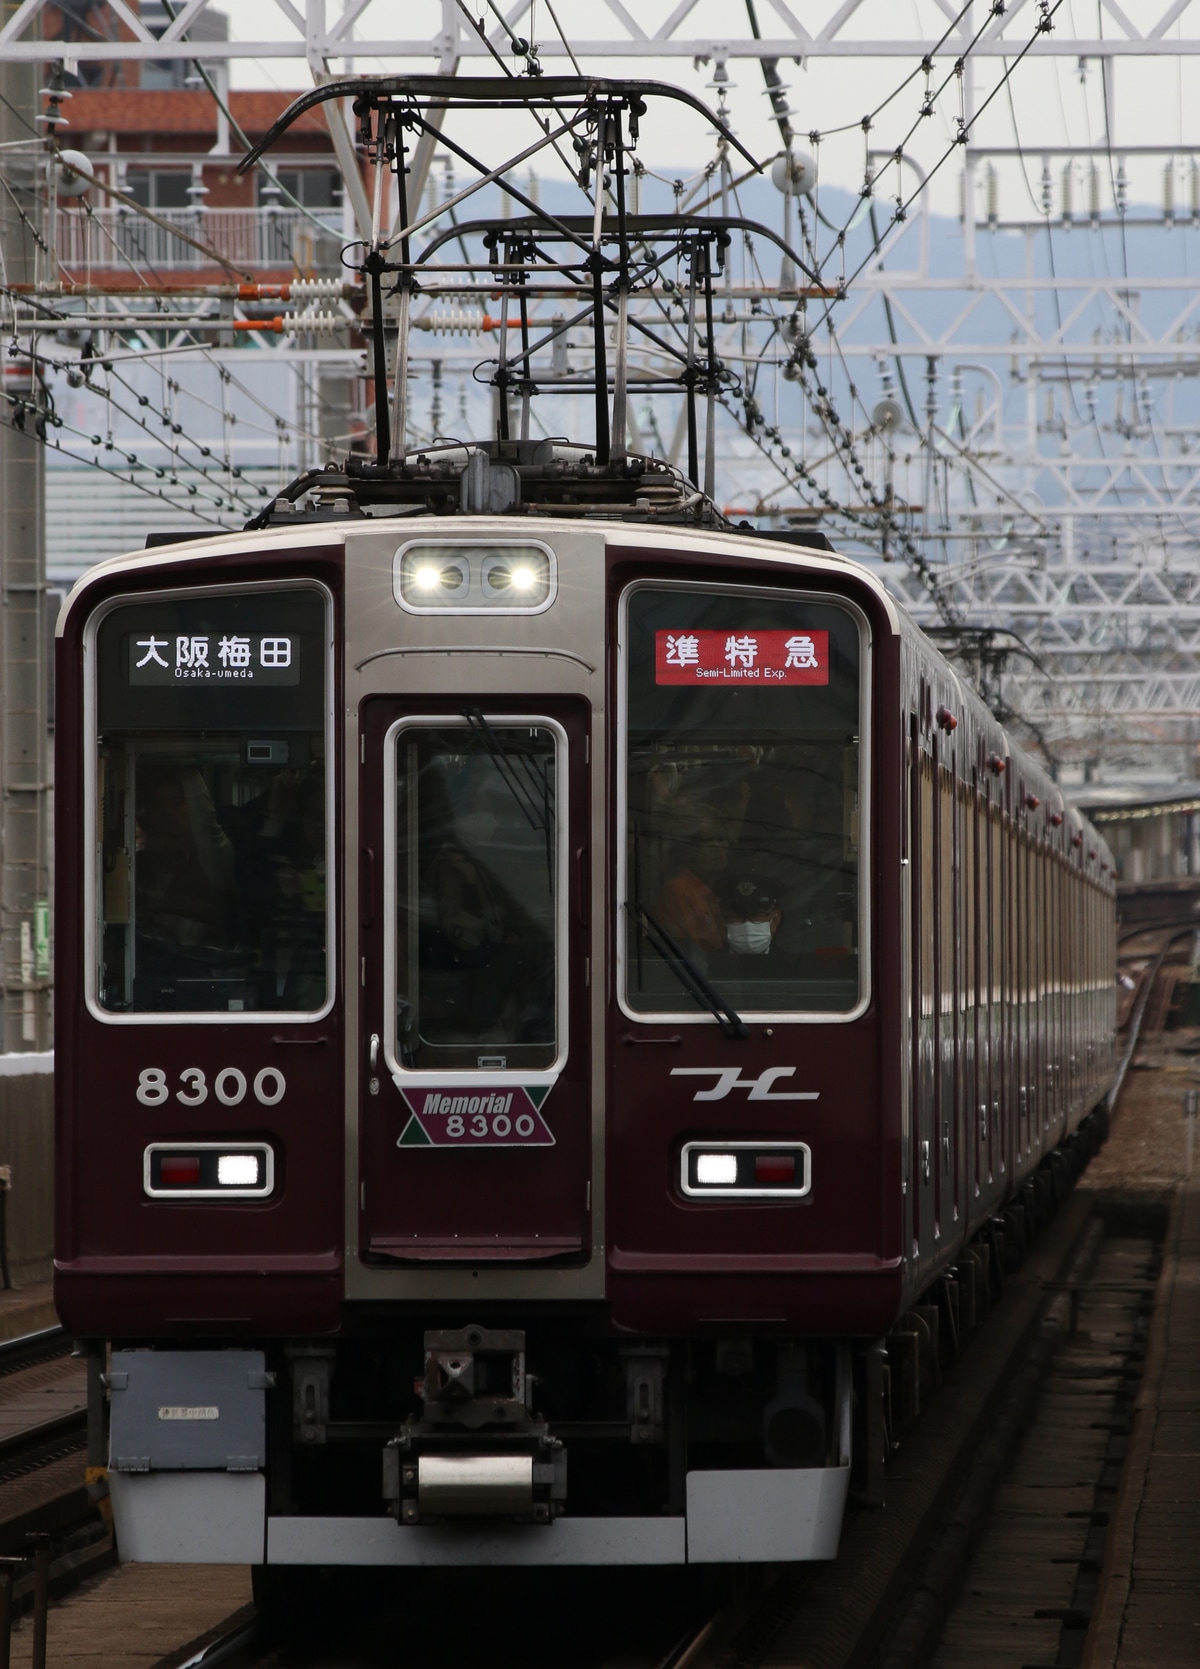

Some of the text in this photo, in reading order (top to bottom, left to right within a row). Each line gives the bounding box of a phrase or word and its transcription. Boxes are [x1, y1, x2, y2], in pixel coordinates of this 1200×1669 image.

[135, 635, 292, 668] 大阪梅田
[665, 635, 819, 668] 準特急
[174, 668, 254, 678] Osaka-umeda
[695, 668, 788, 680] Semi-Limited Exp.
[135, 1066, 287, 1107] 8300
[422, 1092, 514, 1115] Memorial
[446, 1114, 535, 1138] 8300
